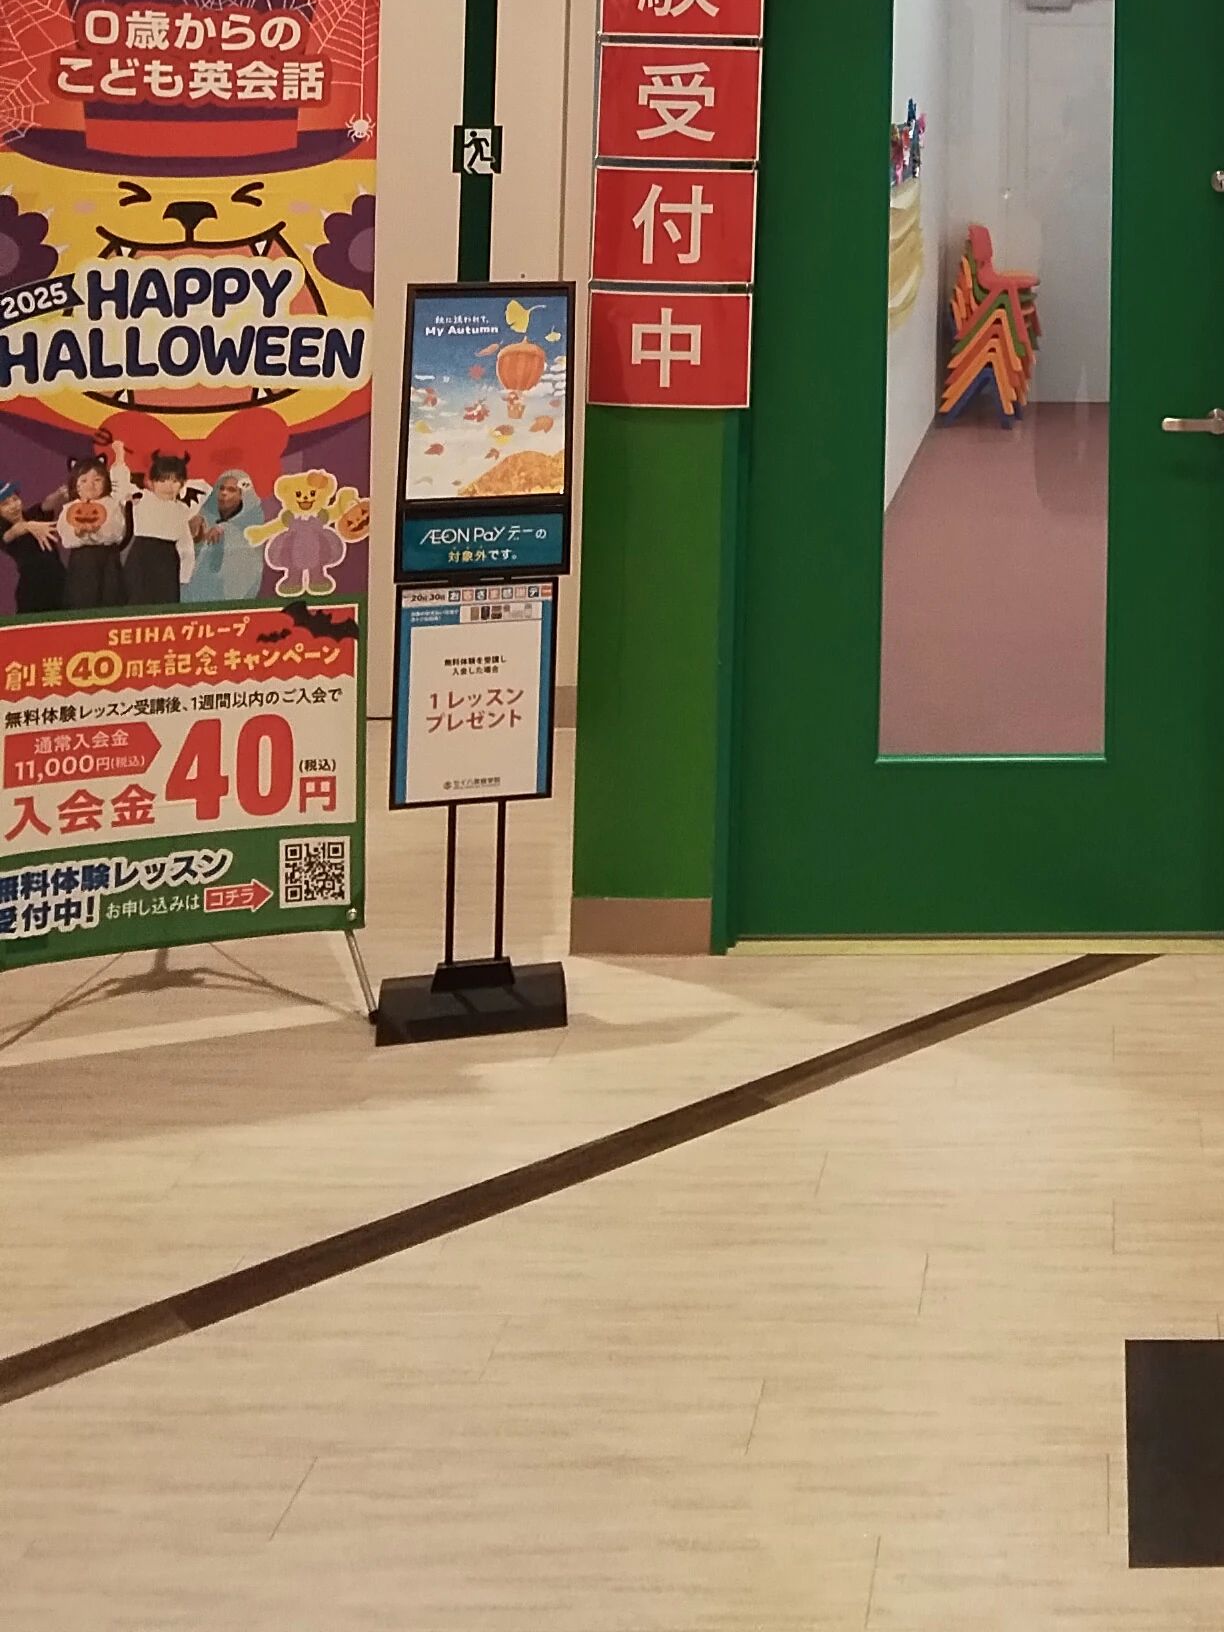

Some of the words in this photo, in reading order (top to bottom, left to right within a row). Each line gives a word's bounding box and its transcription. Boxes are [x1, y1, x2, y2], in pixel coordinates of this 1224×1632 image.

[84, 10, 302, 51] 0歳からの
[57, 57, 325, 102] こども英会話
[1, 283, 67, 319] 2025
[87, 268, 292, 321] HAPPY
[425, 326, 444, 337] My
[448, 325, 499, 335] Autumn
[0, 325, 365, 388] HALLOWEEN
[108, 625, 176, 647] SEIHA
[181, 615, 251, 642] グループ
[426, 709, 523, 734] プレゼント
[34, 728, 129, 754] 通常入会金
[165, 713, 294, 822] 40
[298, 757, 338, 773] (税込)
[299, 774, 338, 814] 円
[4, 783, 157, 842] 入会金
[106, 891, 200, 920] お申し込みは
[210, 888, 256, 909] コチラ
